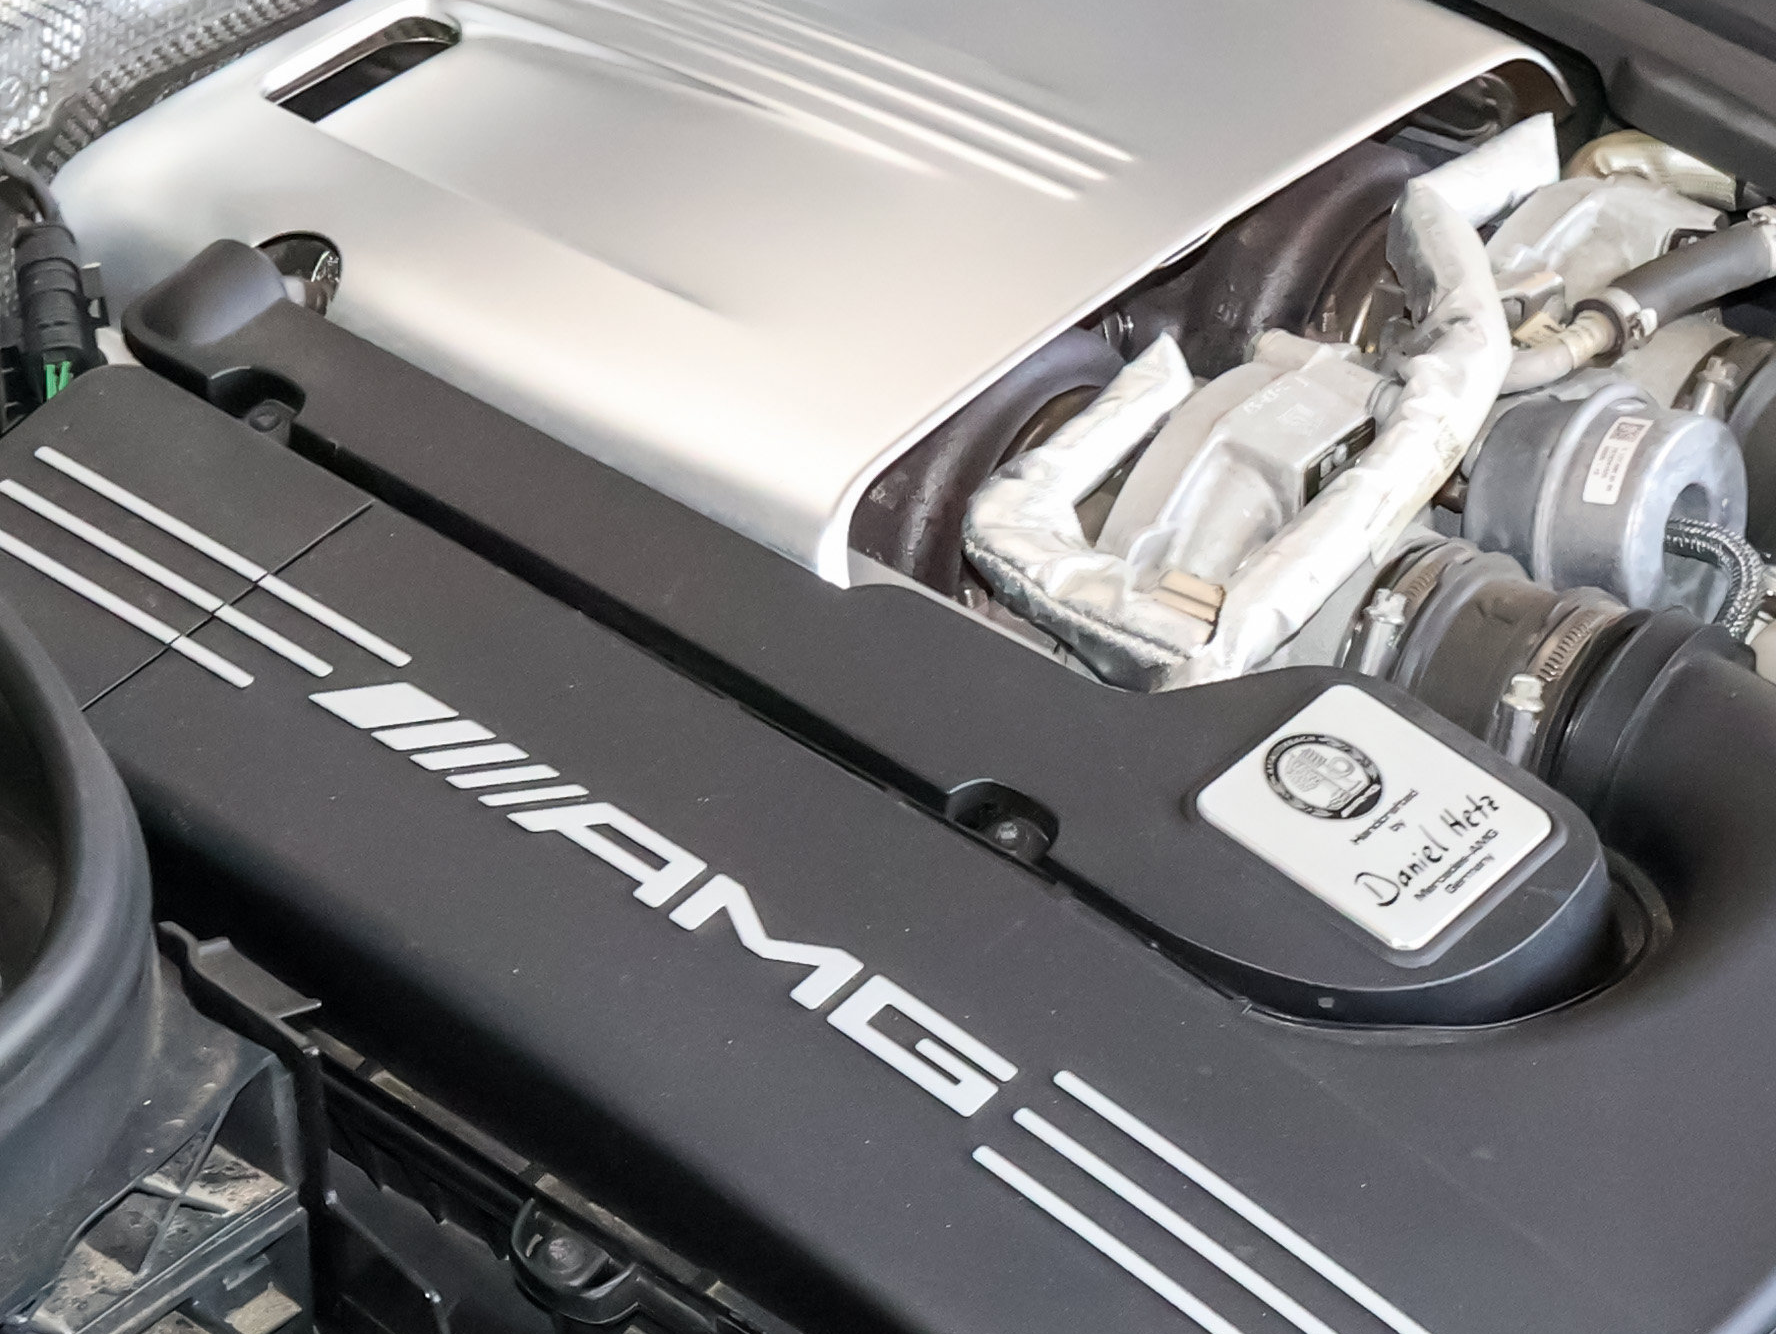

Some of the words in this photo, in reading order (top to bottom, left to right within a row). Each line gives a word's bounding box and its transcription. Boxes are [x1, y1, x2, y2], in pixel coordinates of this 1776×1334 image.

[1350, 788, 1419, 846] Handcrafted
[1389, 819, 1408, 833] by
[1354, 825, 1450, 907] Daniel
[1413, 828, 1499, 902] Mercedes-AMG
[1446, 854, 1495, 895] Germany
[508, 802, 1018, 1117] AMG
